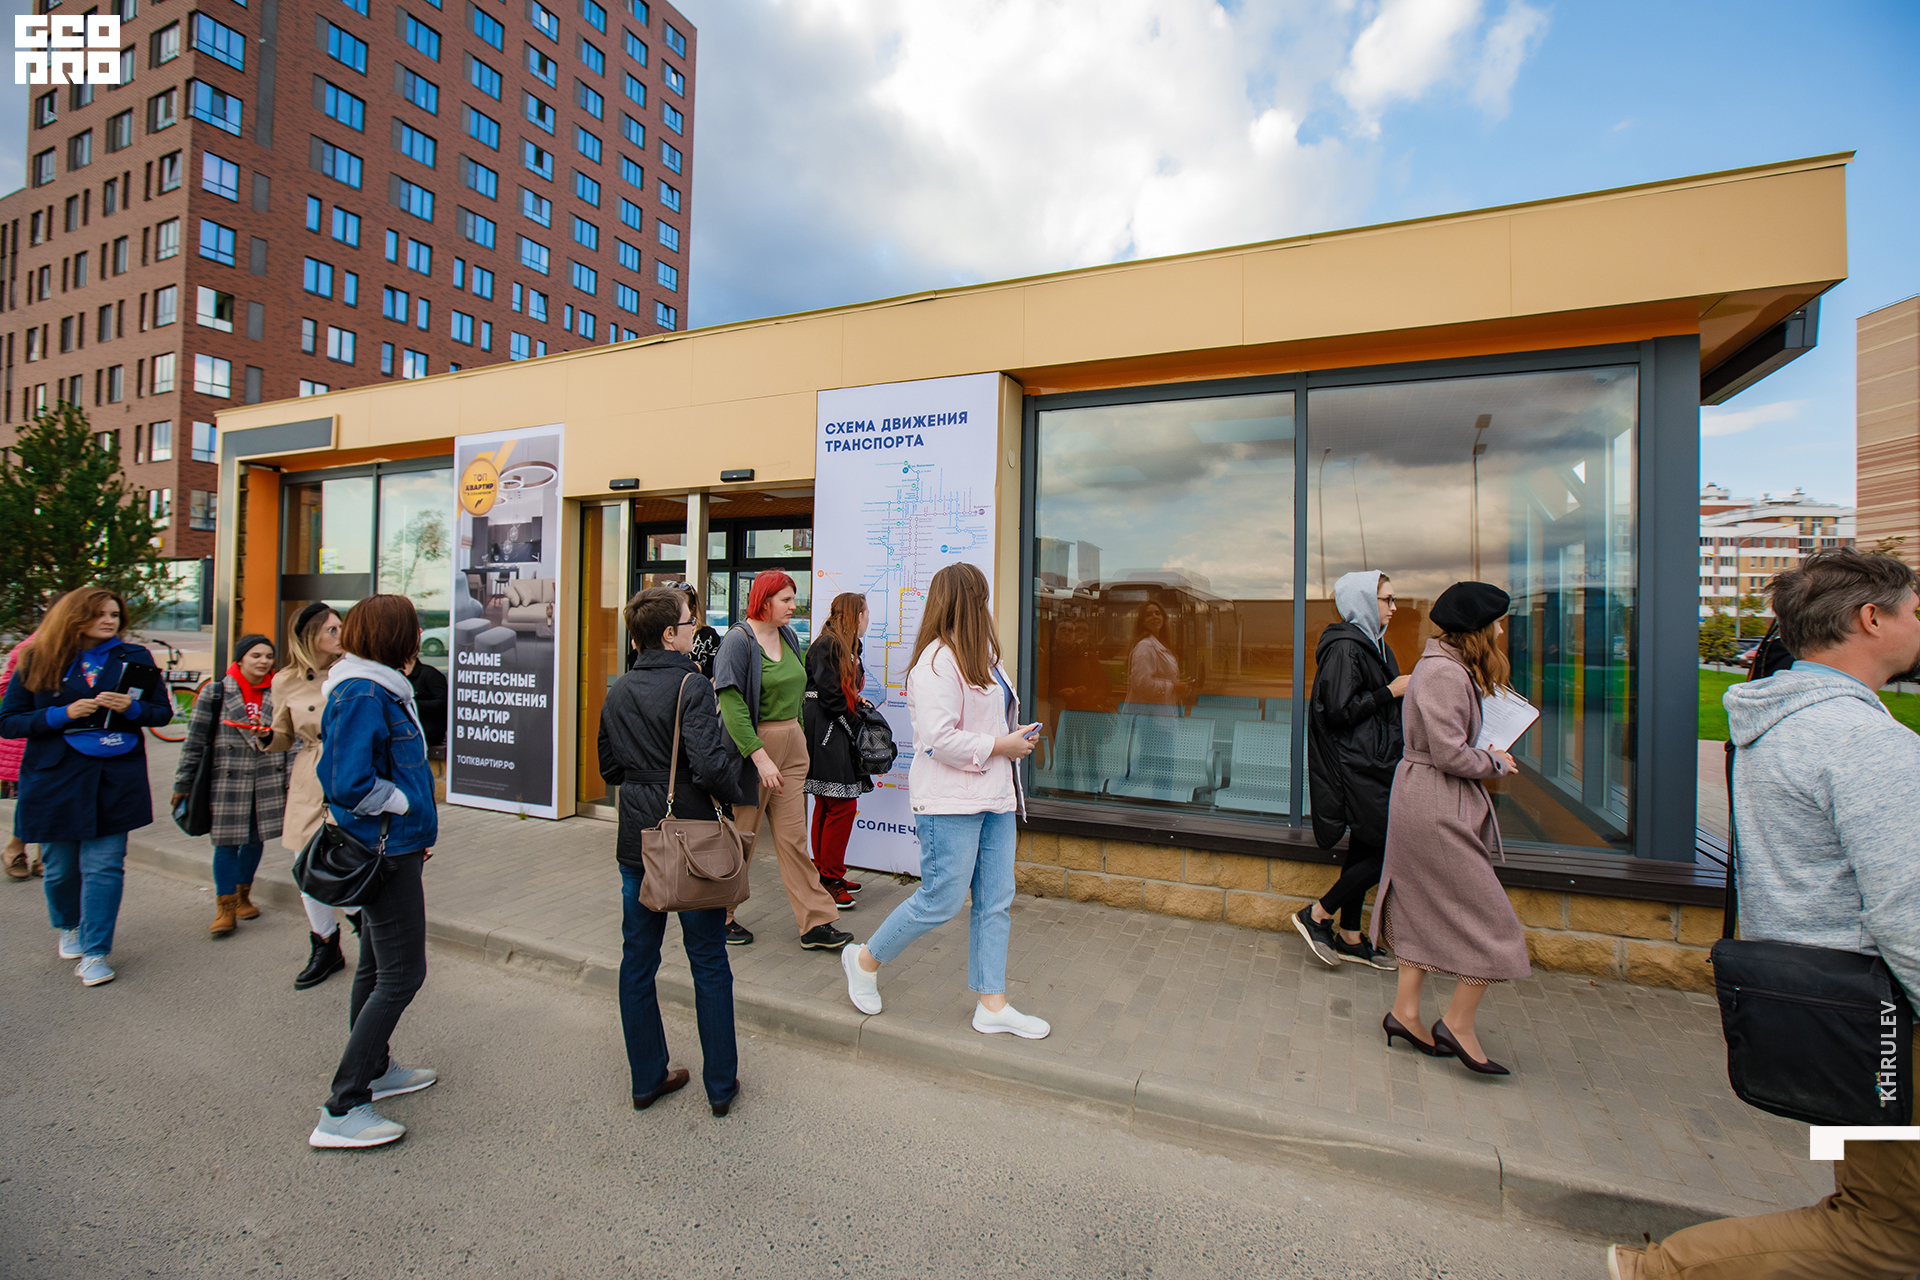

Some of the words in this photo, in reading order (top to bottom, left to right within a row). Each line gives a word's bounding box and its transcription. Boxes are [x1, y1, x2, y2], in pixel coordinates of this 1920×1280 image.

[825, 419, 876, 435] СХЕМА
[881, 411, 968, 433] ДВИЖЕНИЯ
[825, 433, 924, 453] ТРАНСПОРТА
[473, 473, 488, 482] ТОП
[465, 483, 494, 491] КВАРТИР
[458, 651, 501, 667] САМЫЕ
[457, 670, 536, 688] ИНТЕРЕСНЫЕ
[457, 688, 547, 708] ПРЕДЛОЖЕНИЯ
[457, 707, 510, 725] КВАРТИР
[456, 725, 465, 739] В
[467, 725, 515, 744] РАЙОНЕ
[456, 754, 516, 770] ТОПКВАРТИР.РФ
[856, 819, 917, 836] СОЛНЕЧ
